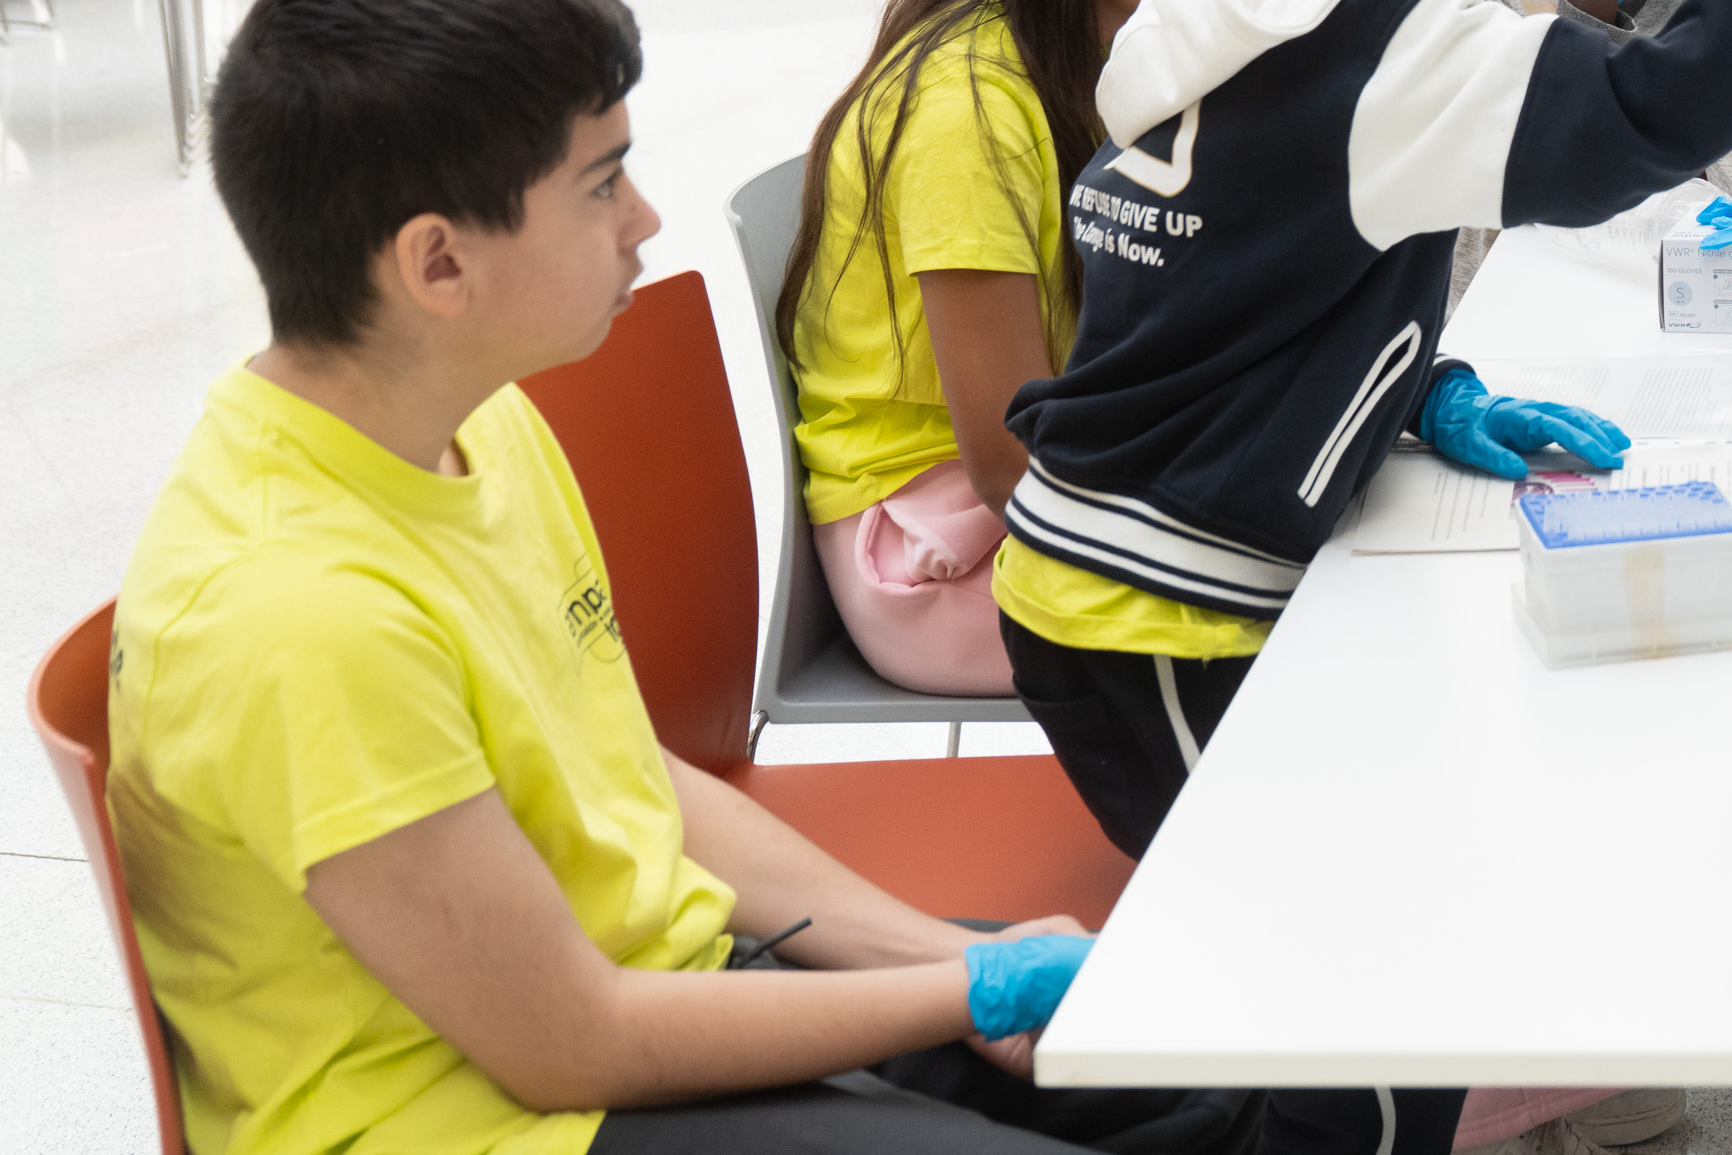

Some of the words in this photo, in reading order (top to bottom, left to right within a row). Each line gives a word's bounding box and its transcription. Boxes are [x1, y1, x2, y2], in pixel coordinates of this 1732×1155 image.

[1110, 195, 1122, 222] TO
[1120, 200, 1160, 233] GIVE
[1165, 210, 1203, 238] UP
[1104, 228, 1115, 254] is
[1117, 233, 1165, 267] Now.
[1697, 247, 1726, 258] Nitrile
[1676, 287, 1685, 299] S
